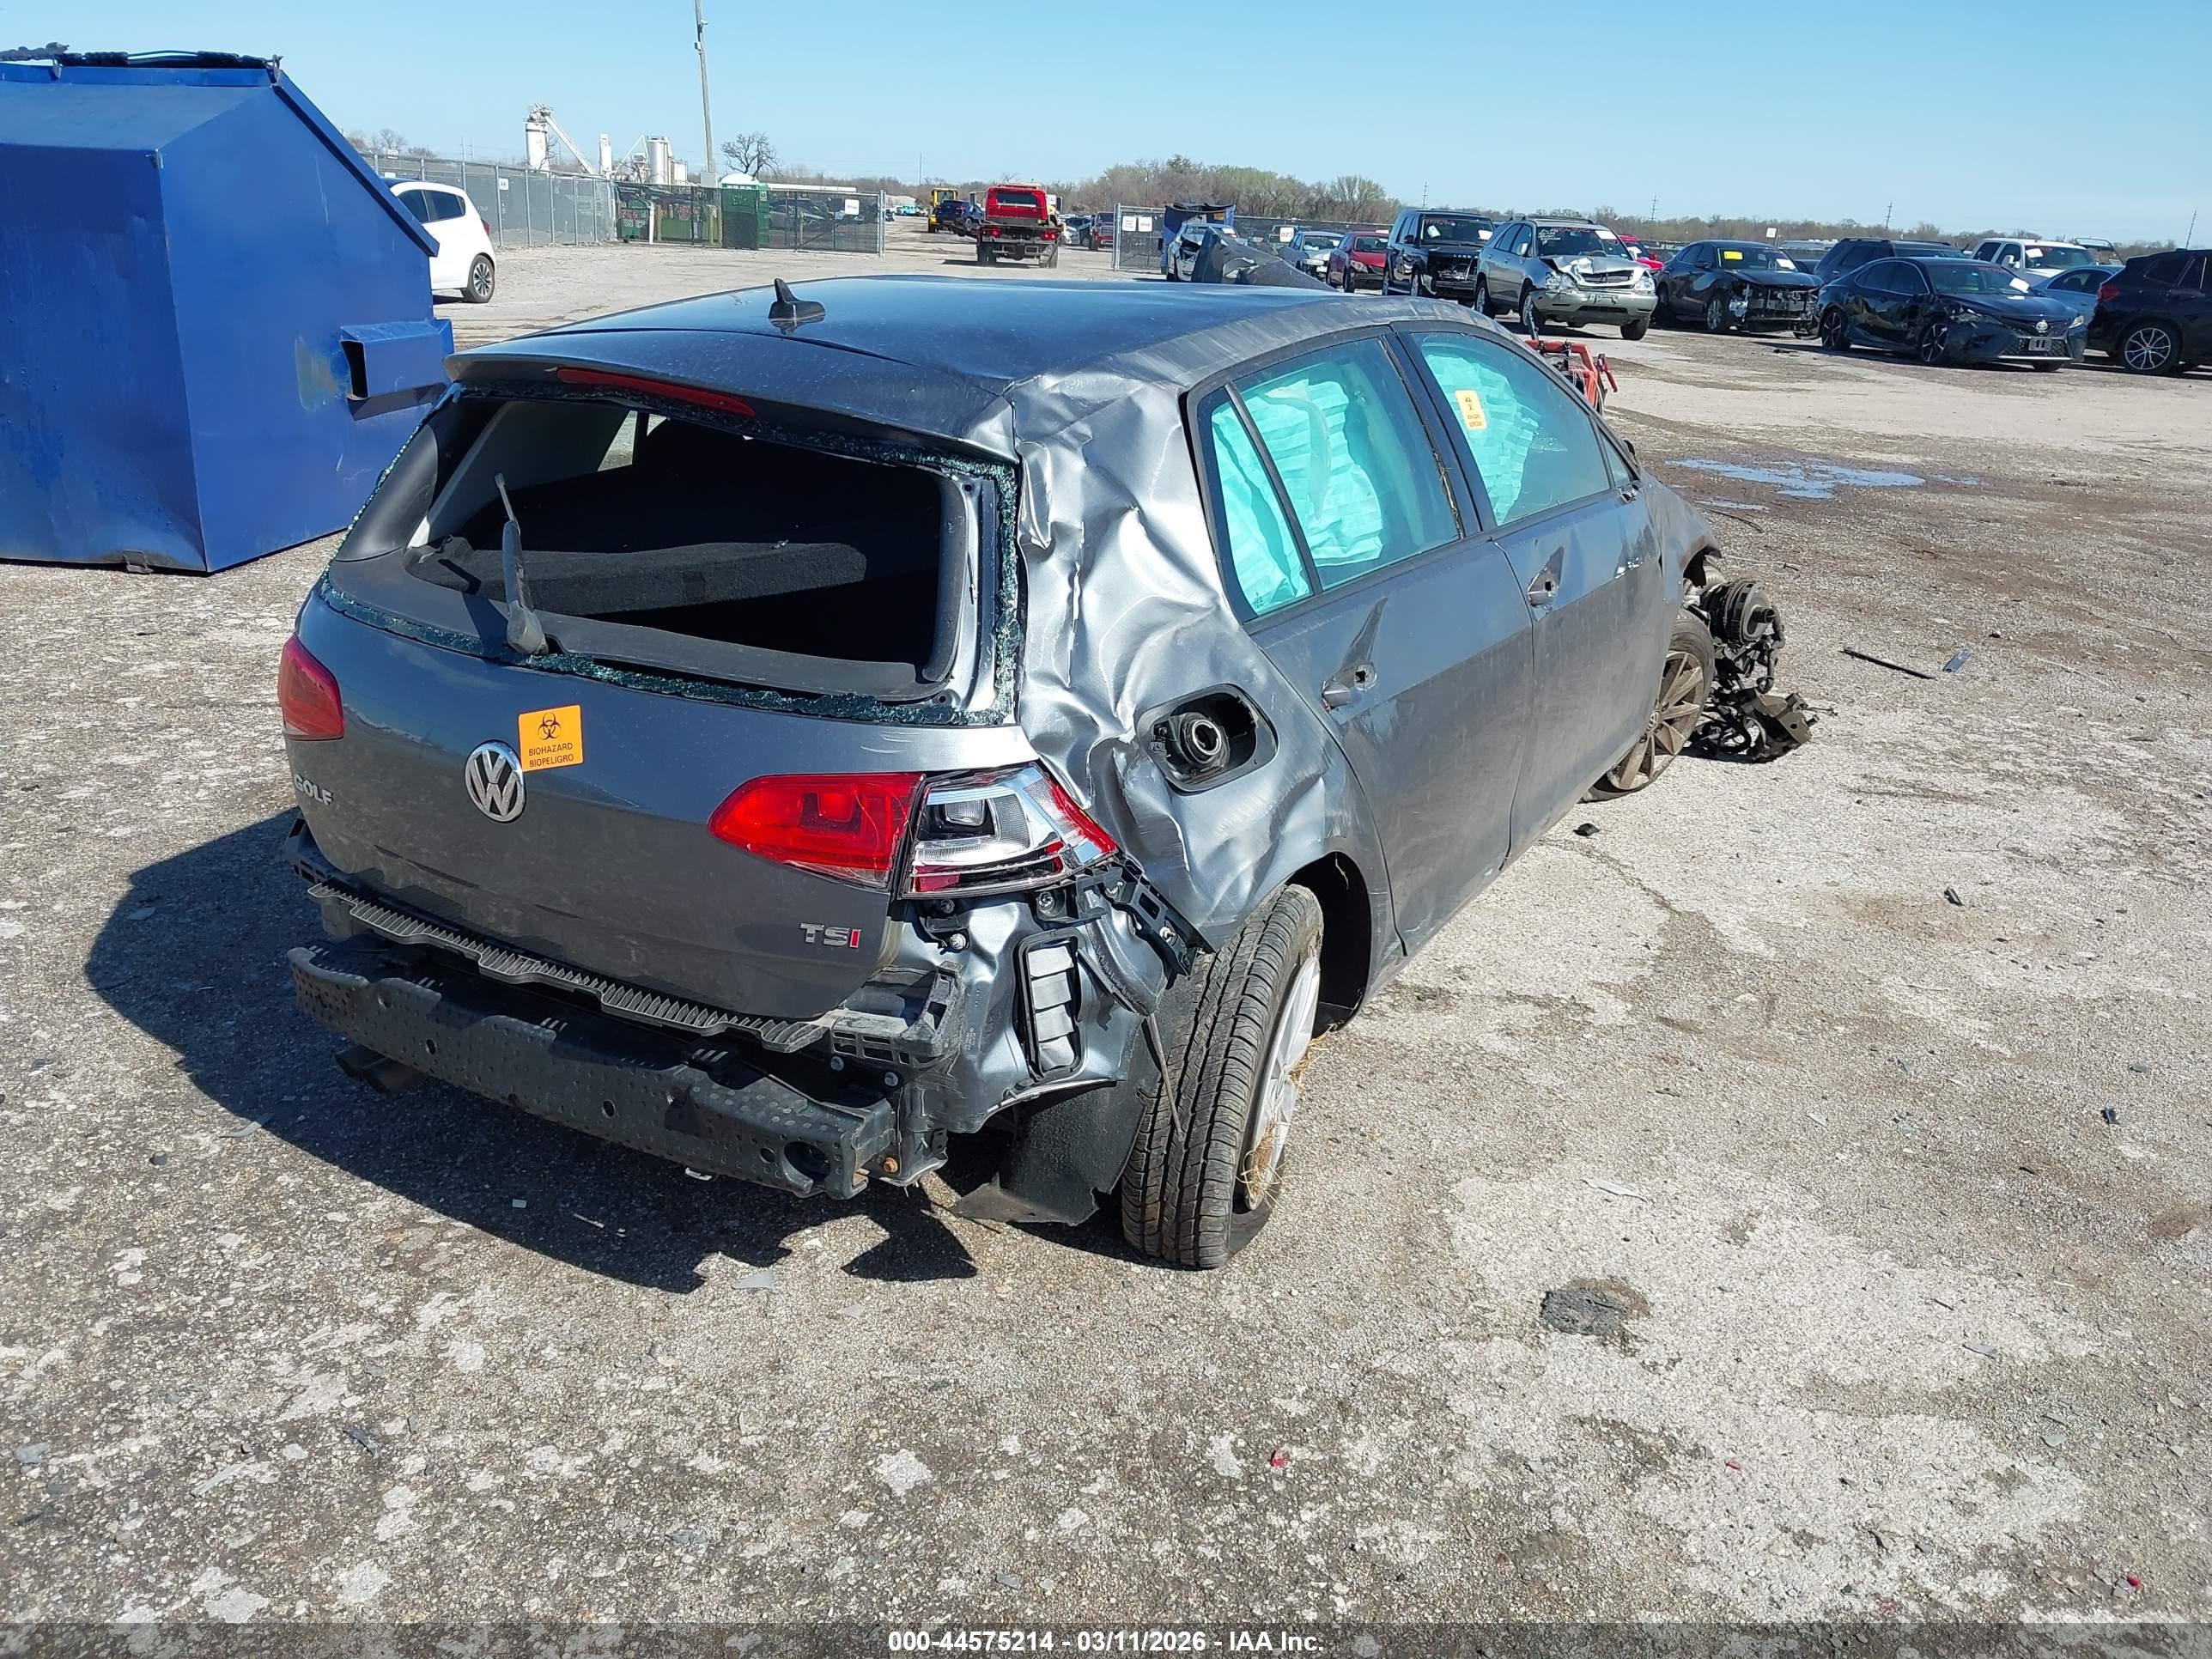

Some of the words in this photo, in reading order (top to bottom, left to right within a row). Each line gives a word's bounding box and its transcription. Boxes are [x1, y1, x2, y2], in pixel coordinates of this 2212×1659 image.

[528, 742, 574, 757] BIOHAZARD
[529, 753, 574, 768] BIOPELIGRO
[294, 773, 333, 806] GOLF
[799, 922, 861, 948] TSI
